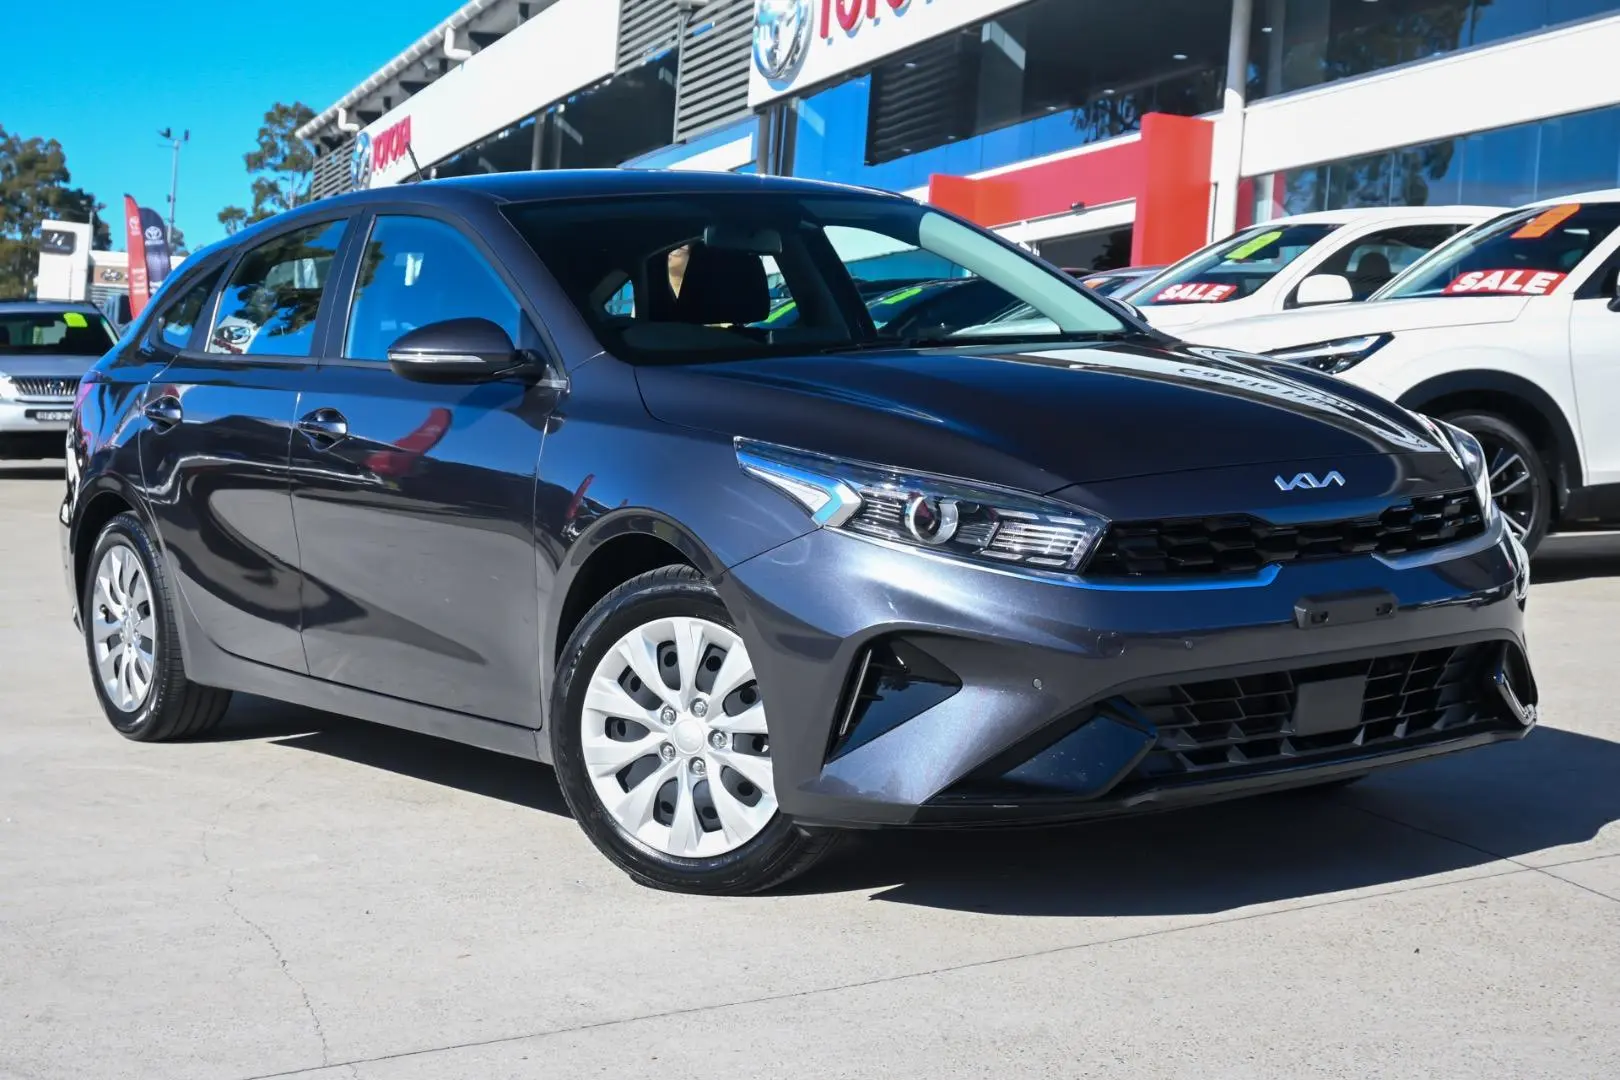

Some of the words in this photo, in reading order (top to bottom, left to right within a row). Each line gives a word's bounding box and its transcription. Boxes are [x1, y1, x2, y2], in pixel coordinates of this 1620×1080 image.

[1158, 284, 1232, 301] SALE
[1452, 270, 1560, 294] SALE
[1274, 470, 1346, 491] KIA
